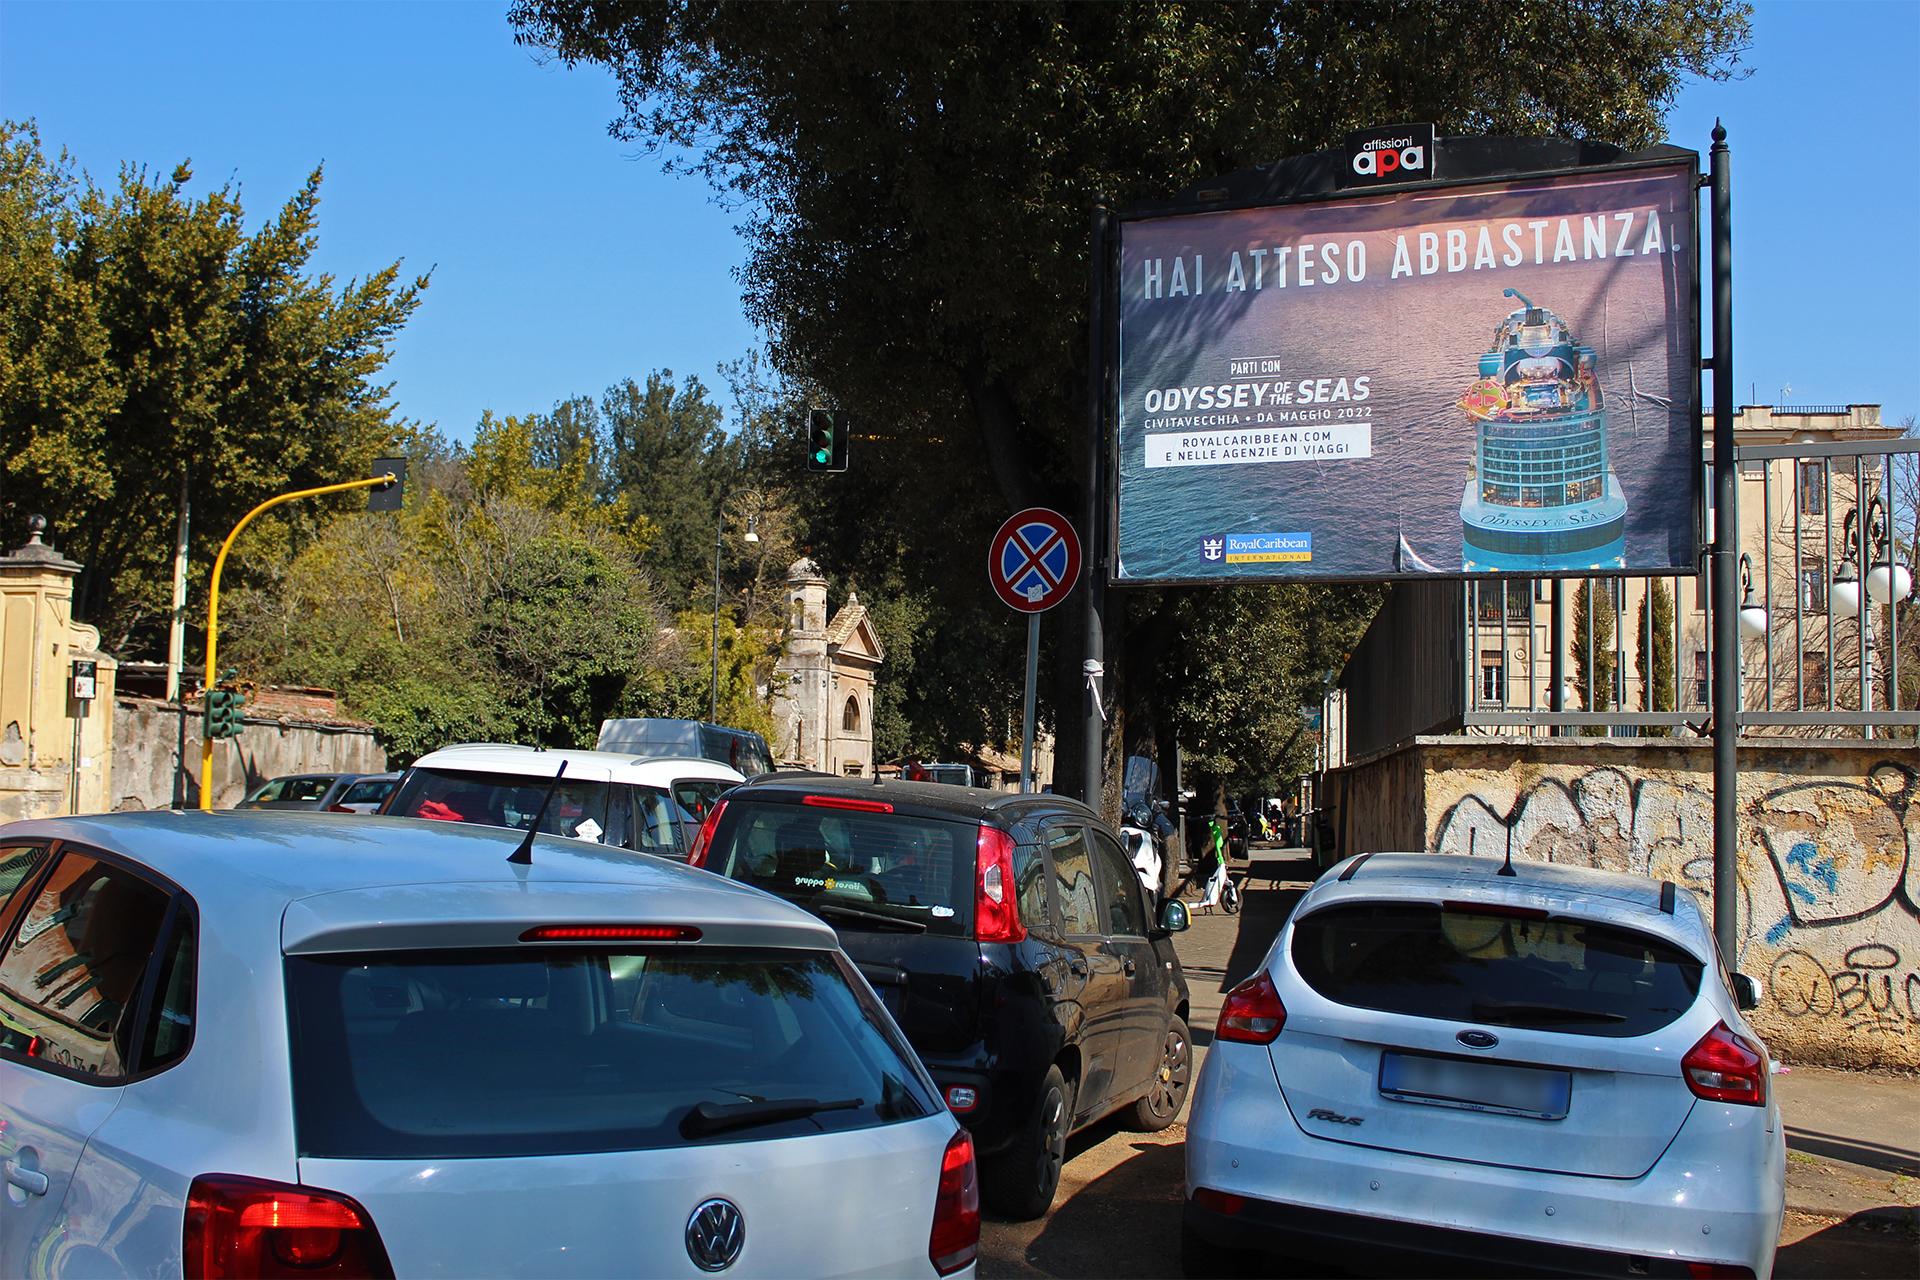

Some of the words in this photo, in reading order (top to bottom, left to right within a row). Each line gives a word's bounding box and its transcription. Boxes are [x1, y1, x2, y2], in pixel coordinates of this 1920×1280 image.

[1363, 136, 1412, 151] affissioni
[1353, 146, 1424, 177] apa
[1144, 255, 1202, 299] HAI
[1226, 241, 1366, 293] ATTESO
[1391, 210, 1681, 279] ABBASTANZA.
[1231, 361, 1258, 375] PARTI
[1262, 360, 1281, 373] CON
[1274, 381, 1292, 393] OF
[1297, 376, 1371, 405] SEAS
[1144, 382, 1271, 413] ODYSSEY
[1269, 393, 1293, 406] THE
[1144, 413, 1240, 429] CIVITAVECCHIA
[1257, 412, 1274, 423] DA
[1280, 409, 1331, 421] MAGGIO
[1337, 407, 1372, 418] 2022
[1182, 431, 1332, 448] ROYALCARIBBEAN.COM
[1165, 451, 1173, 462] E
[1178, 449, 1217, 461] NELLE
[1223, 446, 1279, 459] AGENZIE
[1284, 446, 1297, 456] DI
[1303, 443, 1350, 455] VIAGGI
[795, 876, 824, 887] gruppo
[835, 881, 861, 890] rosati
